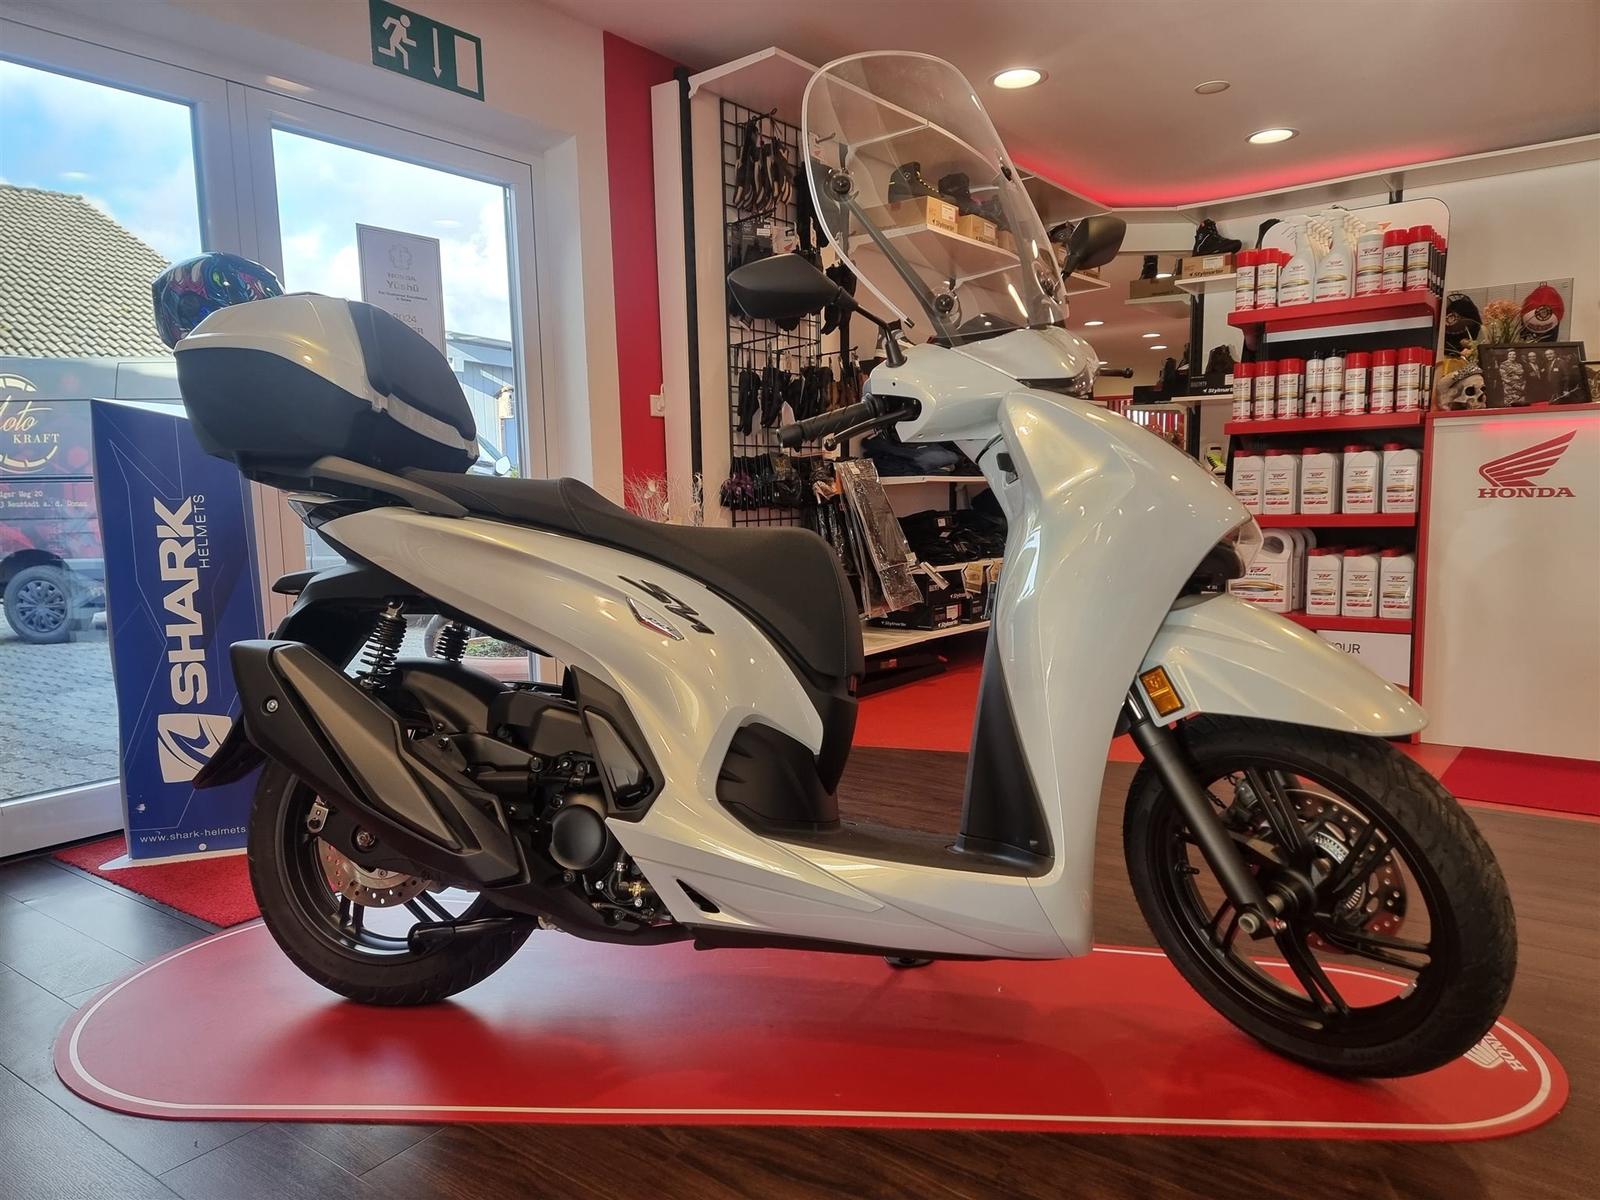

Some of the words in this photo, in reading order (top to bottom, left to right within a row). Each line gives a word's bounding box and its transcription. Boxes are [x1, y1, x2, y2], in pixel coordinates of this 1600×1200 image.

[13, 433, 61, 444] KRAFT
[1478, 487, 1576, 498] HONDA
[192, 494, 211, 568] HELMETS
[153, 497, 208, 706] SHARK
[1332, 641, 1361, 654] OUR
[1484, 1031, 1528, 1072] HON
